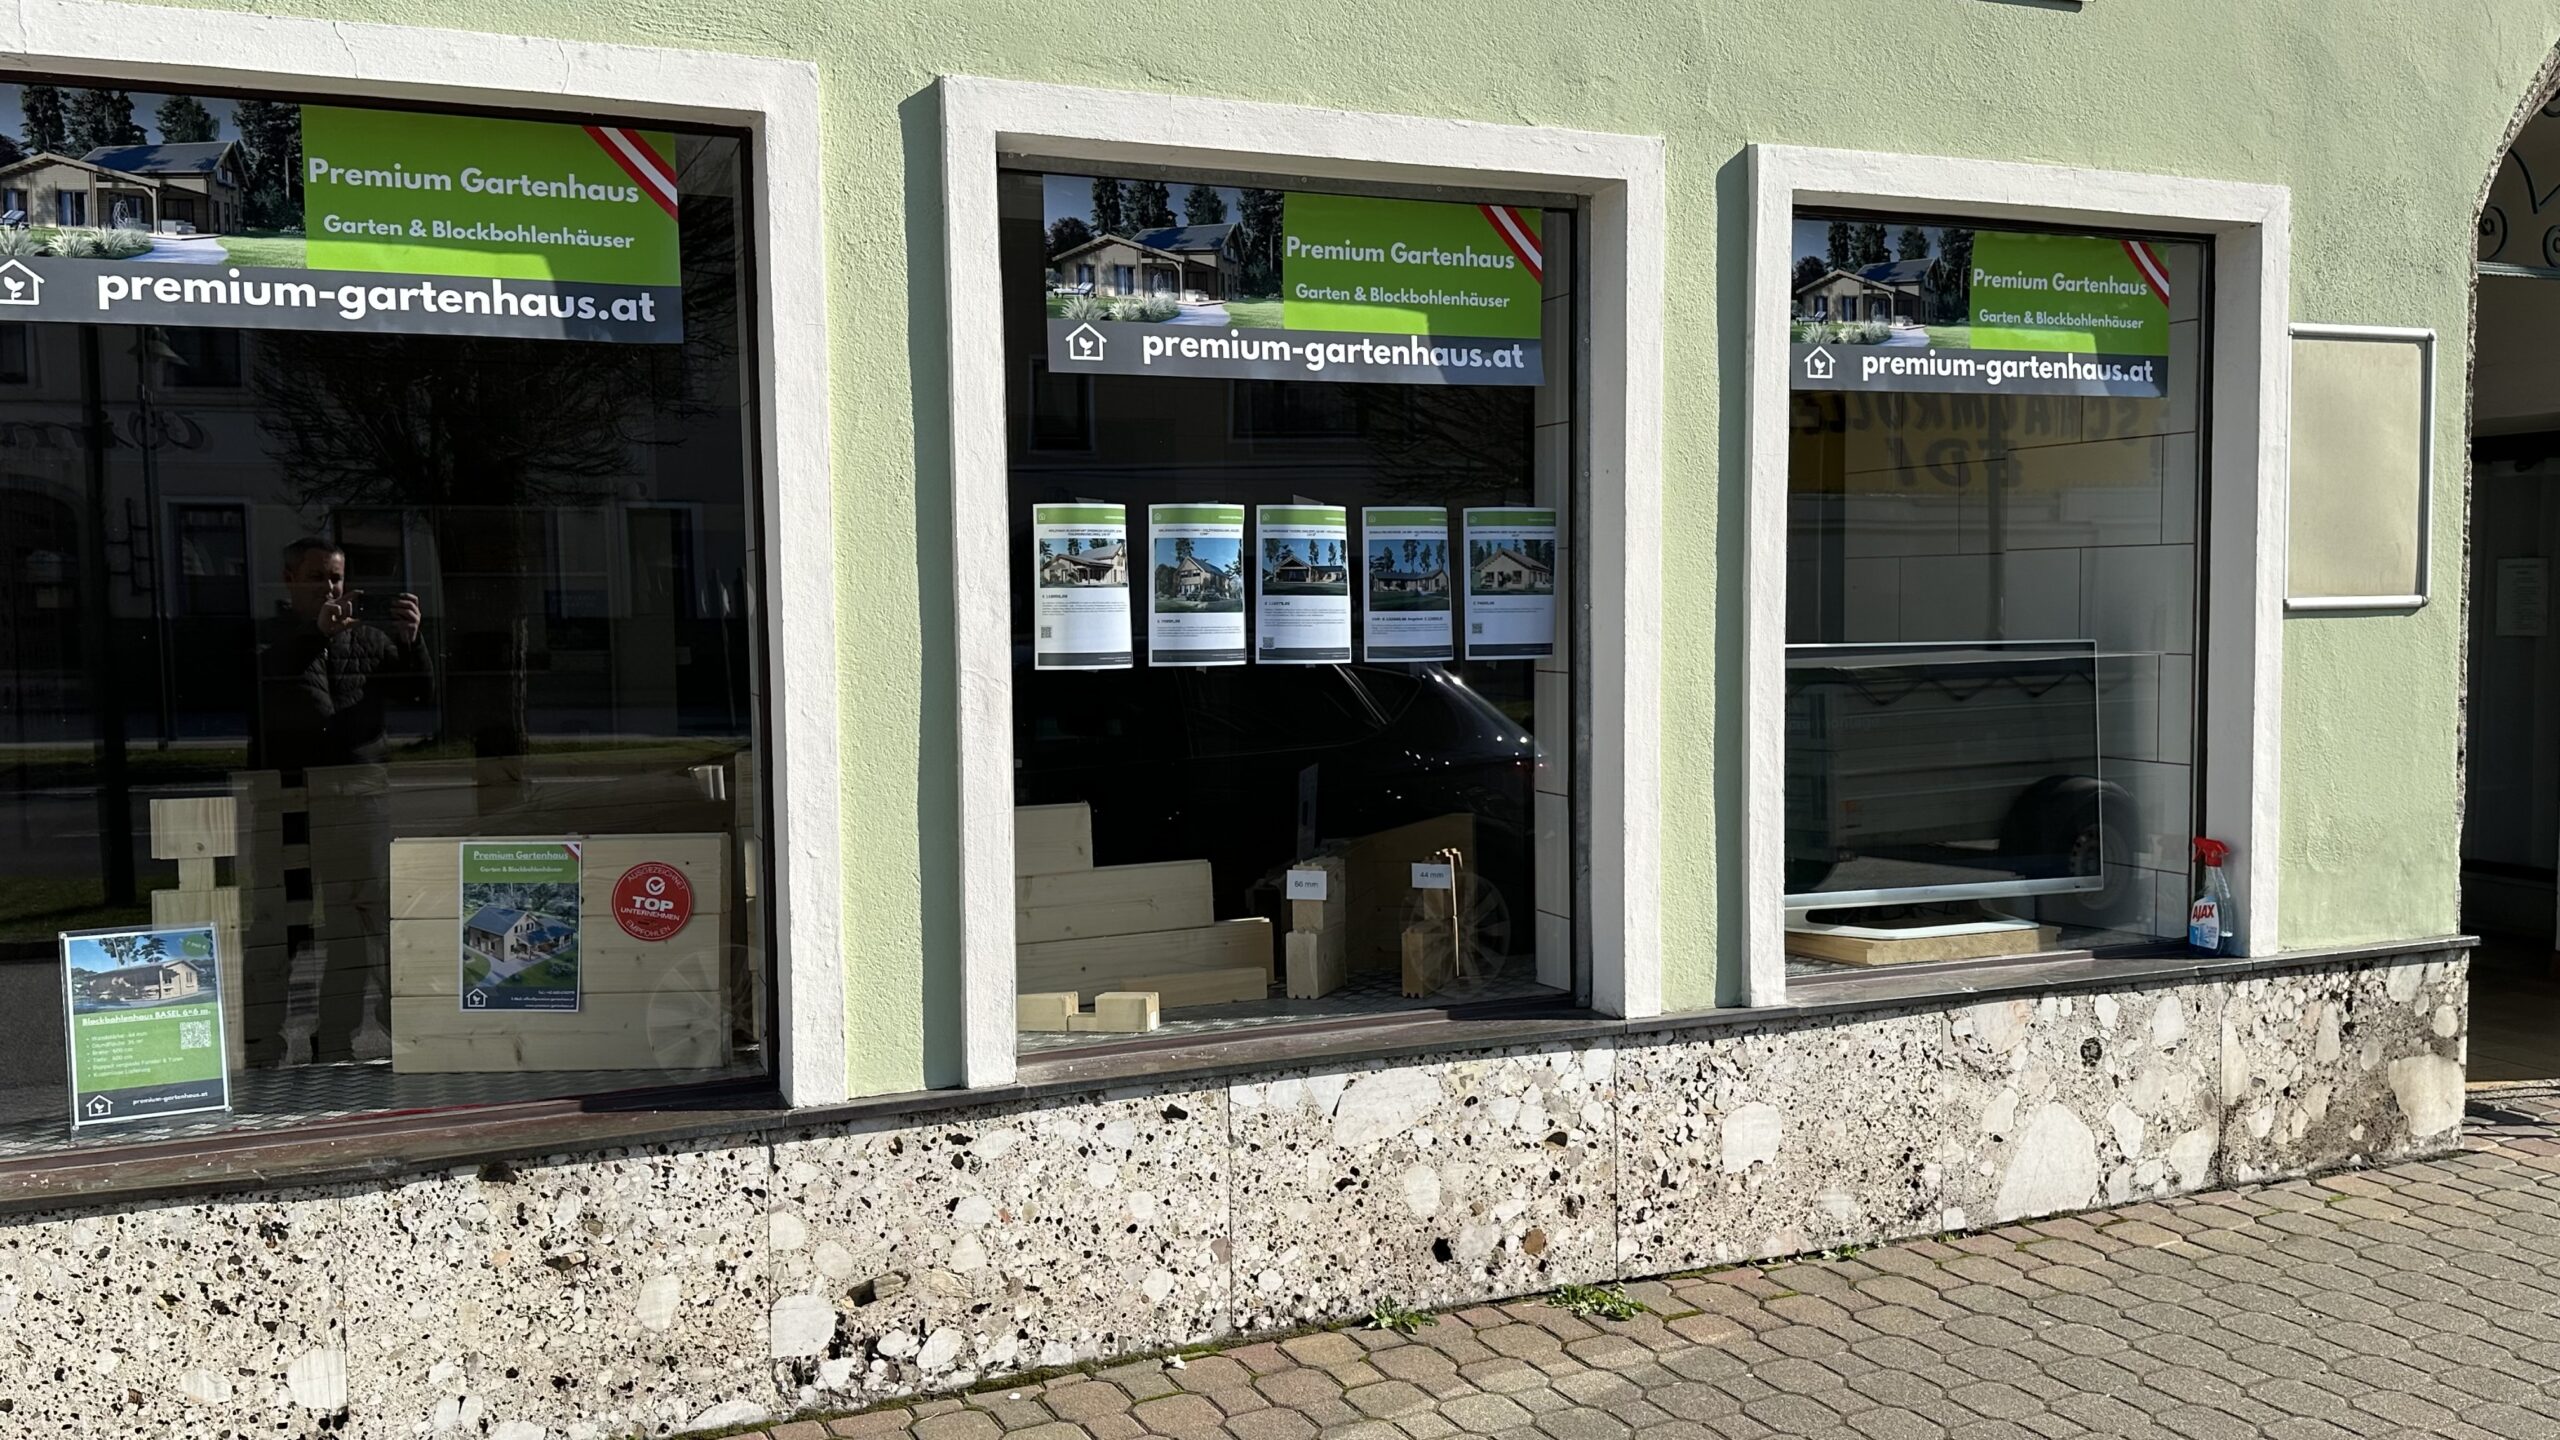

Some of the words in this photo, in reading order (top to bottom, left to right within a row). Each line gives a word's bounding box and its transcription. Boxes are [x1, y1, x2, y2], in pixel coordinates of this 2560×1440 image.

[308, 157, 452, 193] Premium
[460, 167, 640, 204] Gartenhaus
[323, 213, 403, 238] Garten
[409, 219, 427, 238] &
[432, 219, 635, 250] Blockbohlenhäuser
[1286, 236, 1386, 264] Premium
[1390, 242, 1516, 270] Gartenhaus
[1973, 268, 2048, 291] Premium
[2051, 273, 2147, 296] Gartenhaus
[98, 268, 656, 324] premium-gartenhaus.at
[1295, 283, 1350, 302] Garten
[1355, 286, 1366, 301] &
[1370, 286, 1510, 308] Blockbohlenhäuser
[1979, 309, 2021, 325] Garten
[2024, 312, 2034, 324] &
[2036, 311, 2144, 330] Blockbohlenhäuser
[1142, 328, 1524, 371] premium-gartenhaus.at
[1862, 349, 2153, 385] premium-gartenhaus.at
[473, 851, 514, 861] Premium
[516, 851, 569, 861] Gartenhaus
[627, 866, 686, 890] AUSGEZEICHNET
[620, 907, 680, 921] UNTERNEHMEN
[632, 896, 674, 912] TOP
[2192, 904, 2215, 922] AJAX
[626, 919, 671, 937] EMPFOHLEN
[82, 1013, 153, 1026] Blockbohlenhaus
[155, 1009, 181, 1020] BASEL
